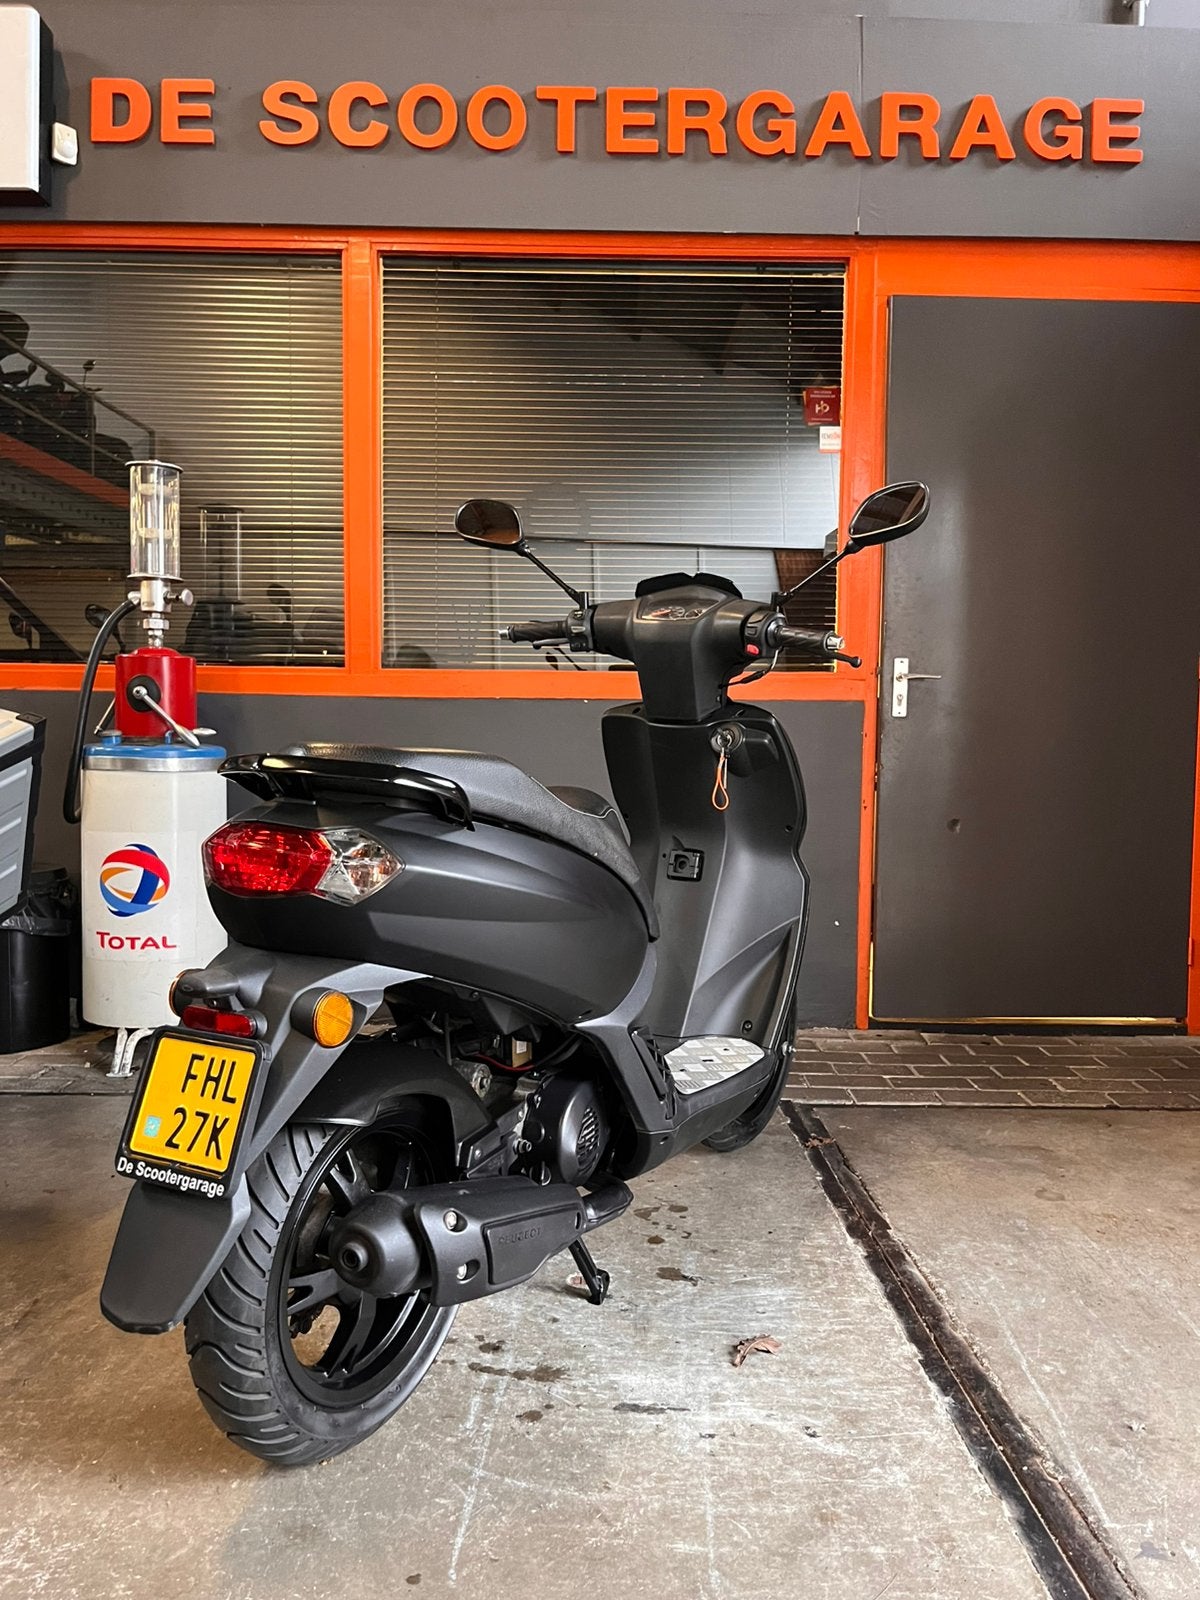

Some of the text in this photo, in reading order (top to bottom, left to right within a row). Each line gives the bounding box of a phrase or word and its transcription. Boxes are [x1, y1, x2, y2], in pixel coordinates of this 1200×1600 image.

[90, 77, 1145, 164] DE SCOOTERGARAGE
[96, 931, 177, 950] TOTAL
[181, 1053, 237, 1104] FHL
[164, 1106, 230, 1161] 27K
[117, 1157, 225, 1198] De Scootergarage
